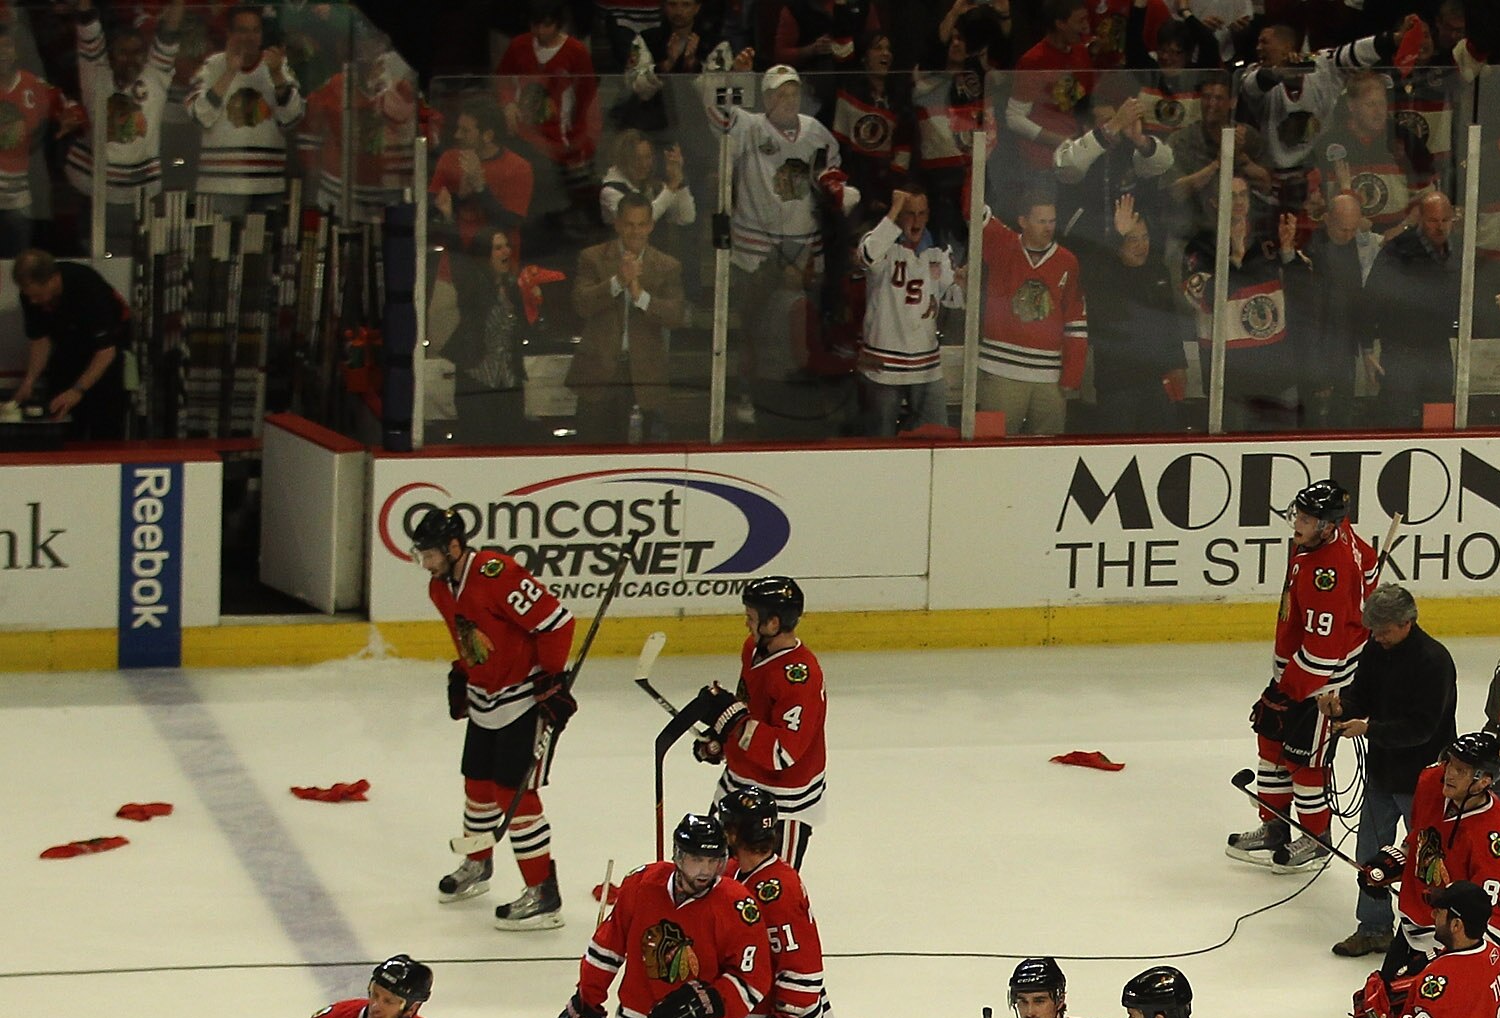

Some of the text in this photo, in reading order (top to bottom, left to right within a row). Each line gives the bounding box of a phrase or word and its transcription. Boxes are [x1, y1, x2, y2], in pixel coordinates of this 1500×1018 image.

[131, 467, 172, 629] Reebok
[464, 541, 716, 577] ORTSNET
[1055, 540, 1180, 588] THE
[506, 577, 544, 617] 22
[546, 579, 746, 599] SNCHICAGO.COM
[1304, 608, 1334, 637] 19
[782, 704, 804, 732] 4
[762, 817, 773, 829] 51
[767, 923, 800, 954] 51
[740, 945, 757, 972] 8
